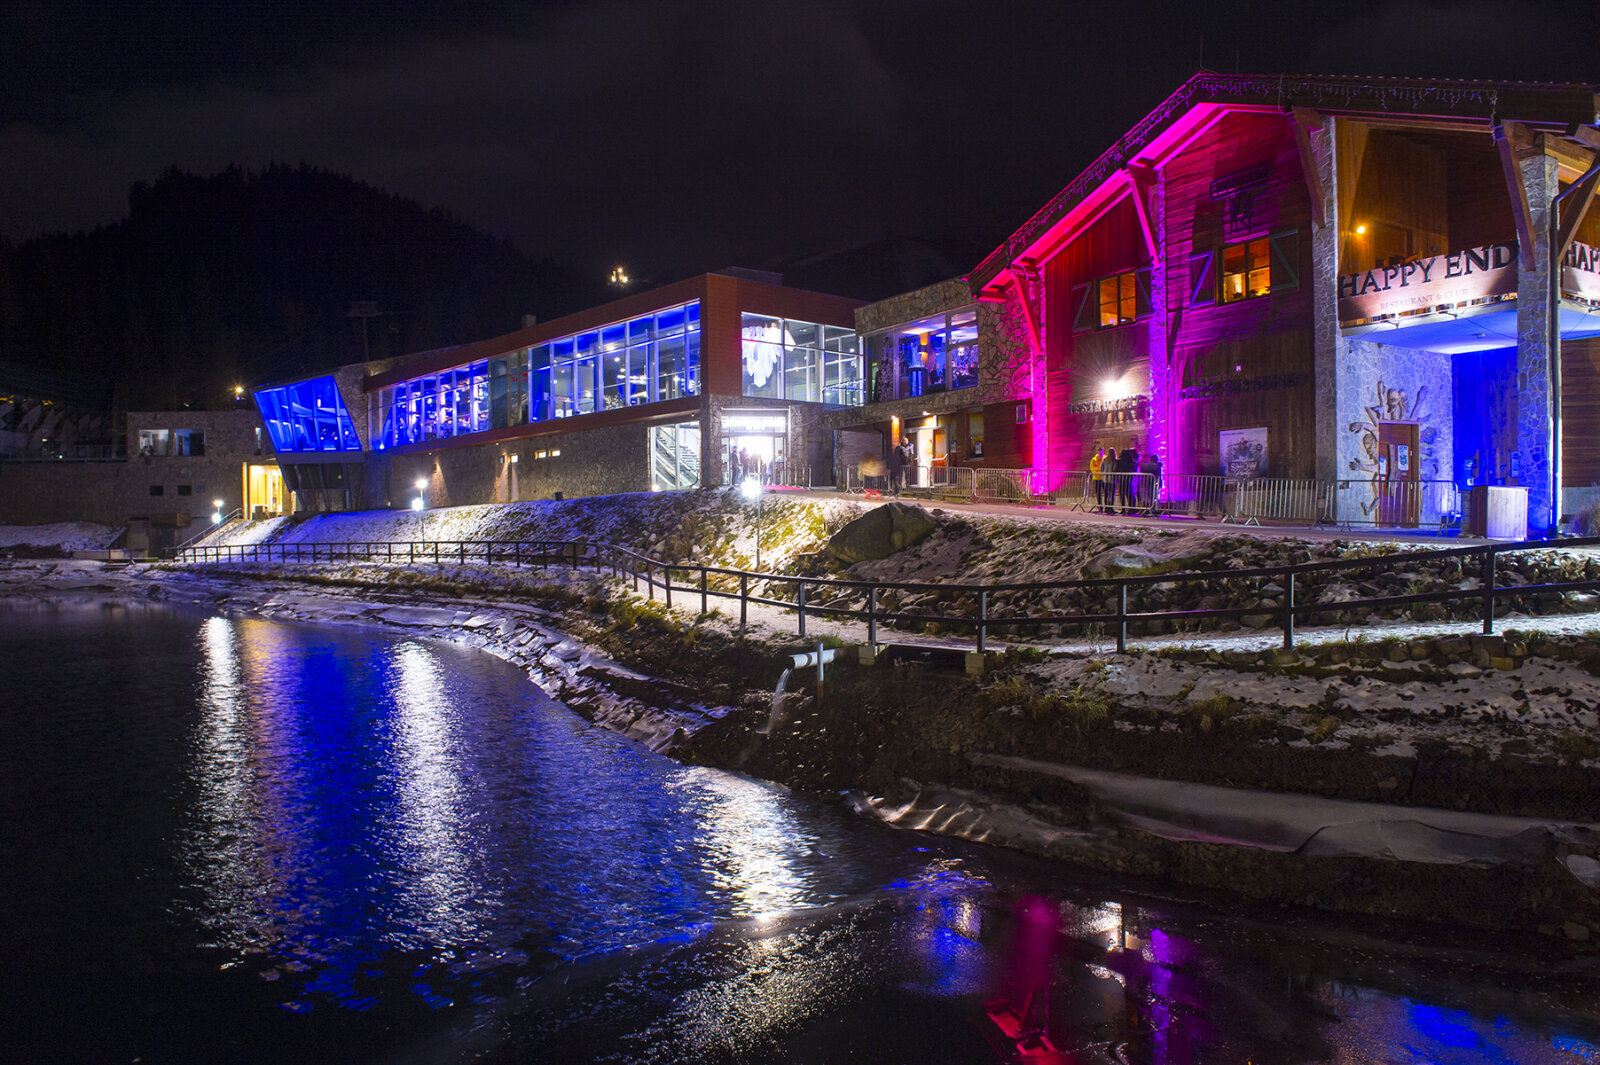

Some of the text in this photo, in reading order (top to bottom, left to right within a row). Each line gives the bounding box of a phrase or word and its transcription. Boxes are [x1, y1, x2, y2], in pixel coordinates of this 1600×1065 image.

[1339, 244, 1518, 298] HAPPY END
[1564, 241, 1600, 274] HAP
[1380, 294, 1433, 310] RESTAURANT
[1444, 288, 1468, 299] CLUB
